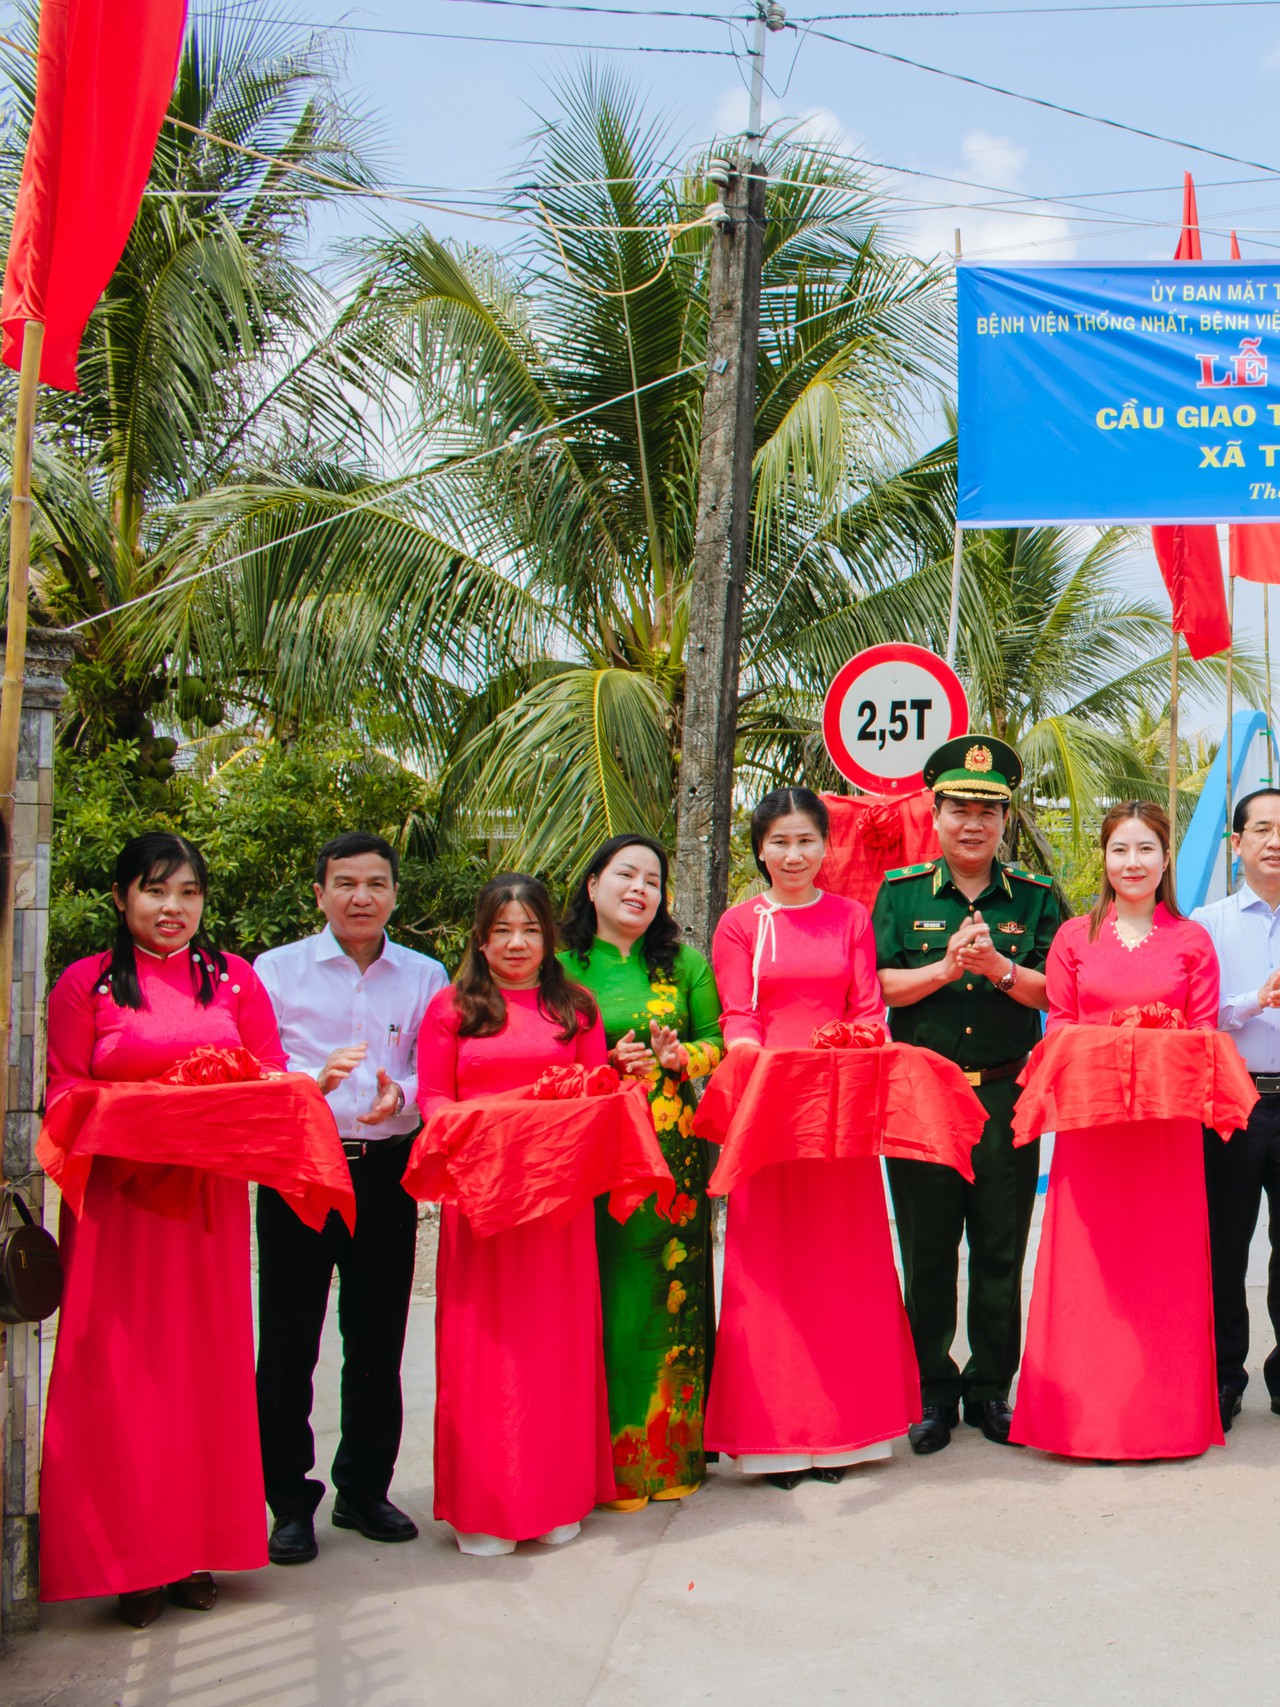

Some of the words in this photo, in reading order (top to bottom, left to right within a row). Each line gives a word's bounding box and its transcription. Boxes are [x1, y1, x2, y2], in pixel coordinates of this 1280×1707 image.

[1151, 279, 1176, 303] ỦY
[1182, 285, 1221, 301] BAN
[1227, 279, 1268, 305] MẶT
[977, 311, 1025, 338] BỆNH
[1029, 311, 1069, 337] VIỆN
[1074, 308, 1135, 332] THỐNG
[1141, 308, 1193, 336] NHẤT,
[1199, 309, 1250, 334] BỆNH
[1195, 338, 1268, 389] LỄ
[1095, 399, 1164, 430] CẦU
[1176, 405, 1257, 428] GIAO
[1199, 439, 1246, 469] XÃ
[856, 698, 933, 751] 2,5T
